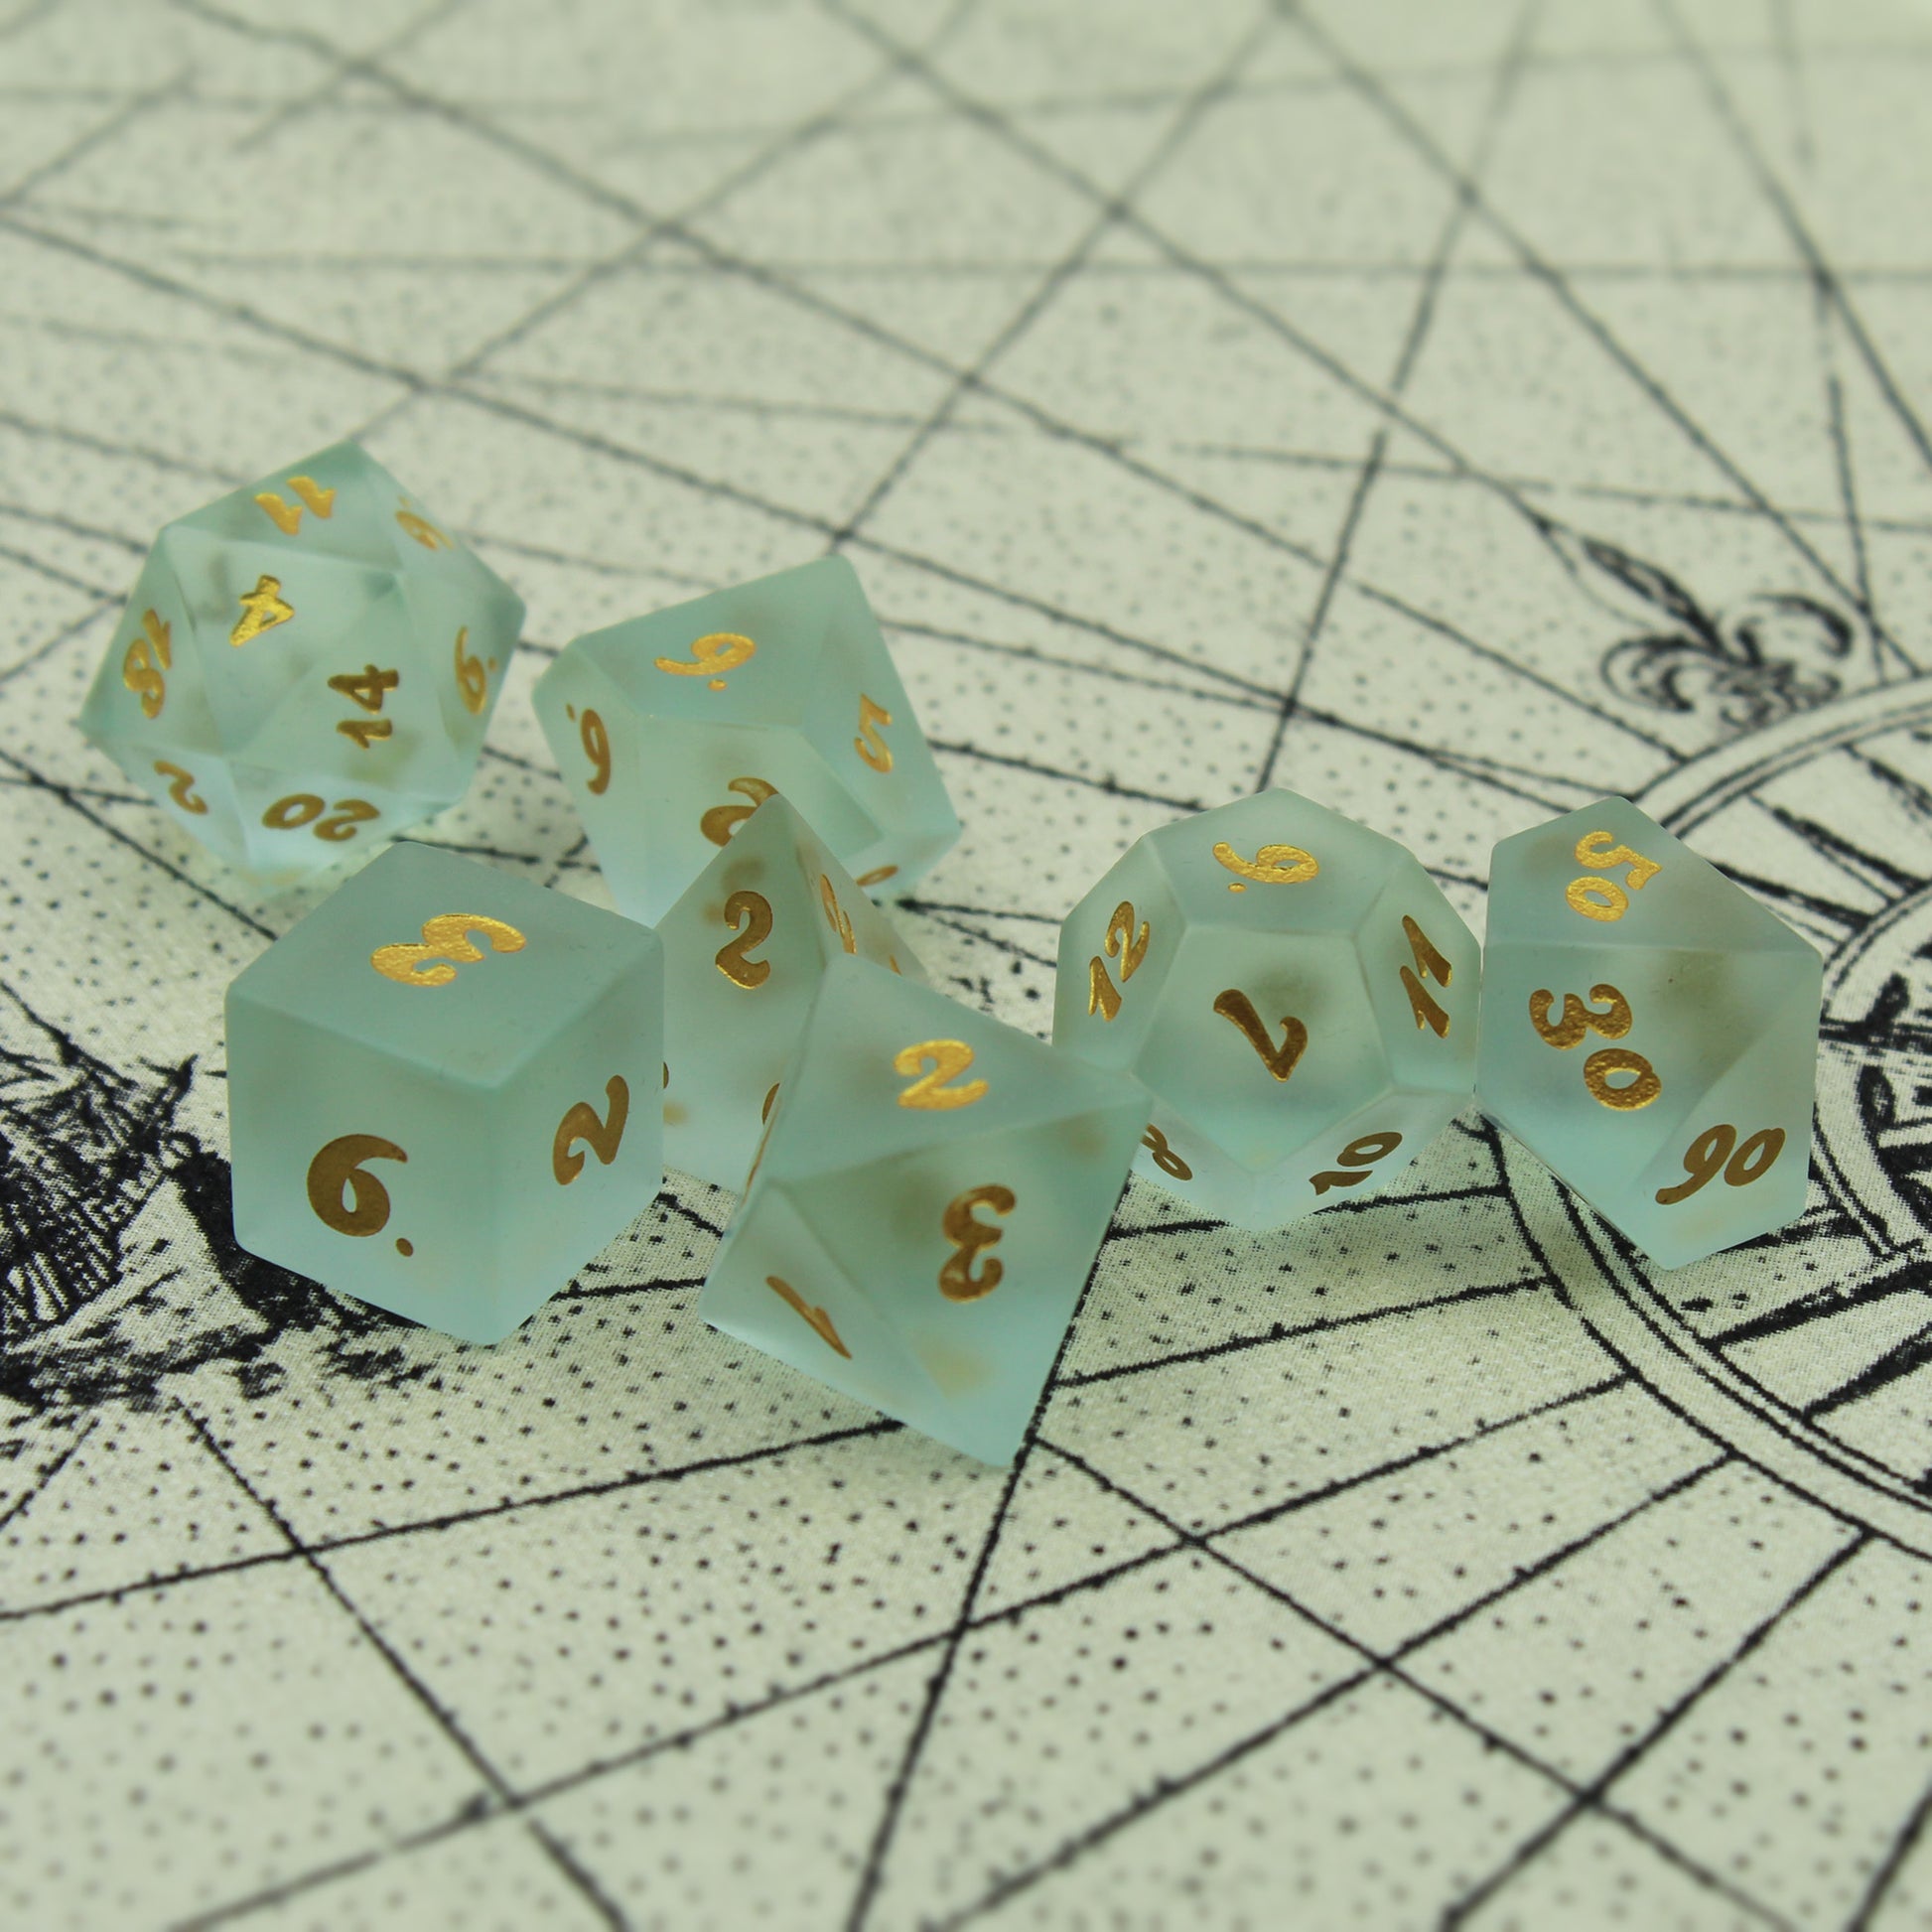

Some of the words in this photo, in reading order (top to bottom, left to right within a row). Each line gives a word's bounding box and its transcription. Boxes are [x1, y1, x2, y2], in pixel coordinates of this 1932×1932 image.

[230, 575, 296, 648] 4
[123, 609, 173, 720] 18
[329, 666, 399, 751] 14
[155, 761, 207, 815] 2
[266, 794, 378, 841] 20
[1564, 830, 1663, 923] 50
[370, 913, 528, 988] 3
[710, 889, 774, 991] 2
[1088, 900, 1151, 1023] 12
[1399, 914, 1452, 1039] 11
[892, 1038, 990, 1111] 2
[1528, 983, 1663, 1112] 30
[553, 1075, 629, 1186] 2
[1311, 1132, 1403, 1195] 10
[1655, 1123, 1786, 1205] 90
[937, 1184, 1017, 1303] 3
[765, 1275, 852, 1359] 1
